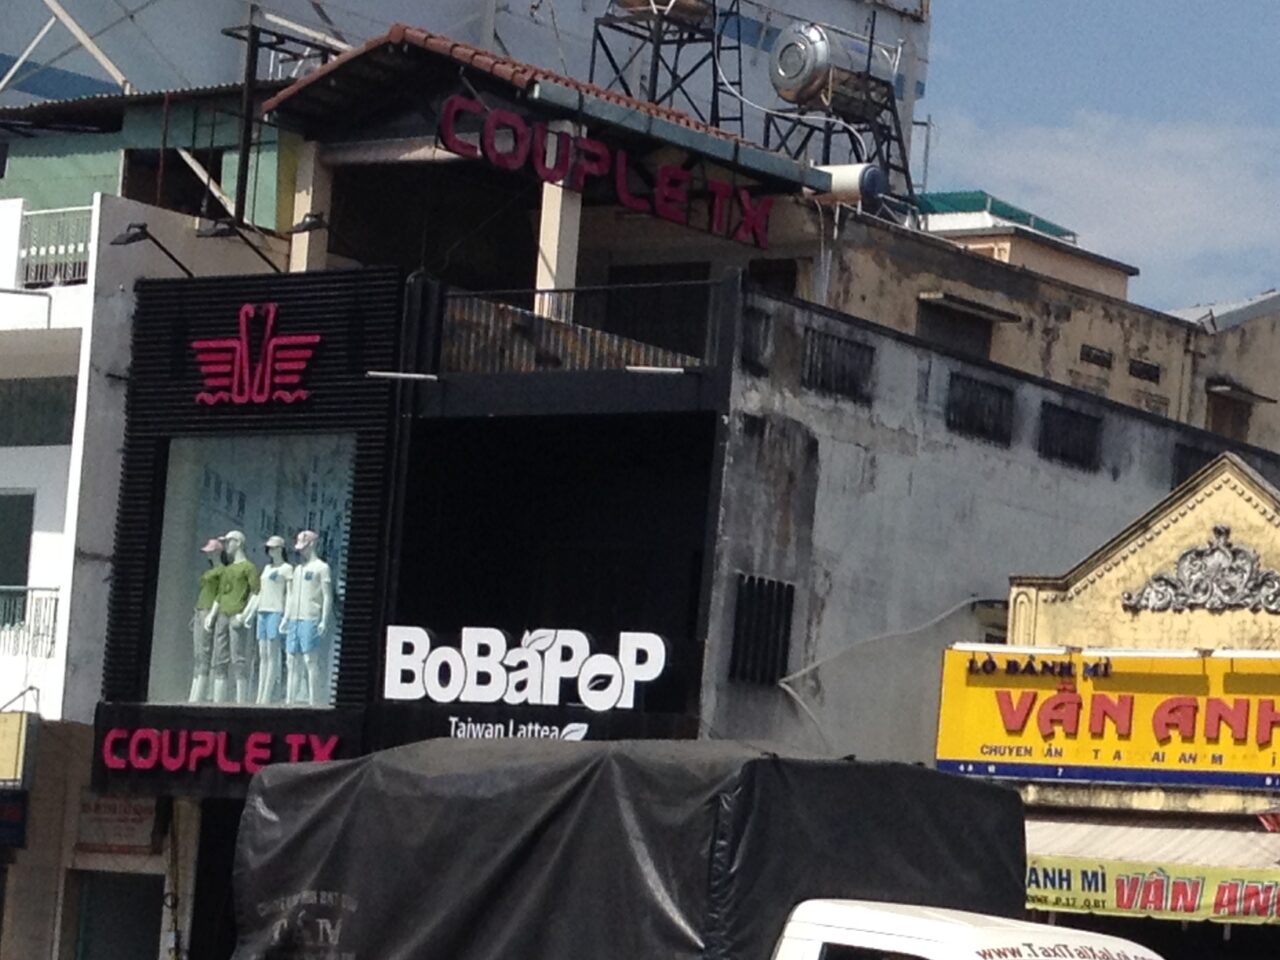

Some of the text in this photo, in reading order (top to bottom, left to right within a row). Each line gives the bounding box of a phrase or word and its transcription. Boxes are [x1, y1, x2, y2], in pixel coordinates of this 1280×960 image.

[438, 95, 774, 250] COUPLE TX
[449, 716, 560, 739] Taiwan Lattea
[102, 728, 342, 773] COUPLE TX
[1027, 861, 1107, 893] ÁNH MÌ
[1114, 868, 1205, 913] VÂN
